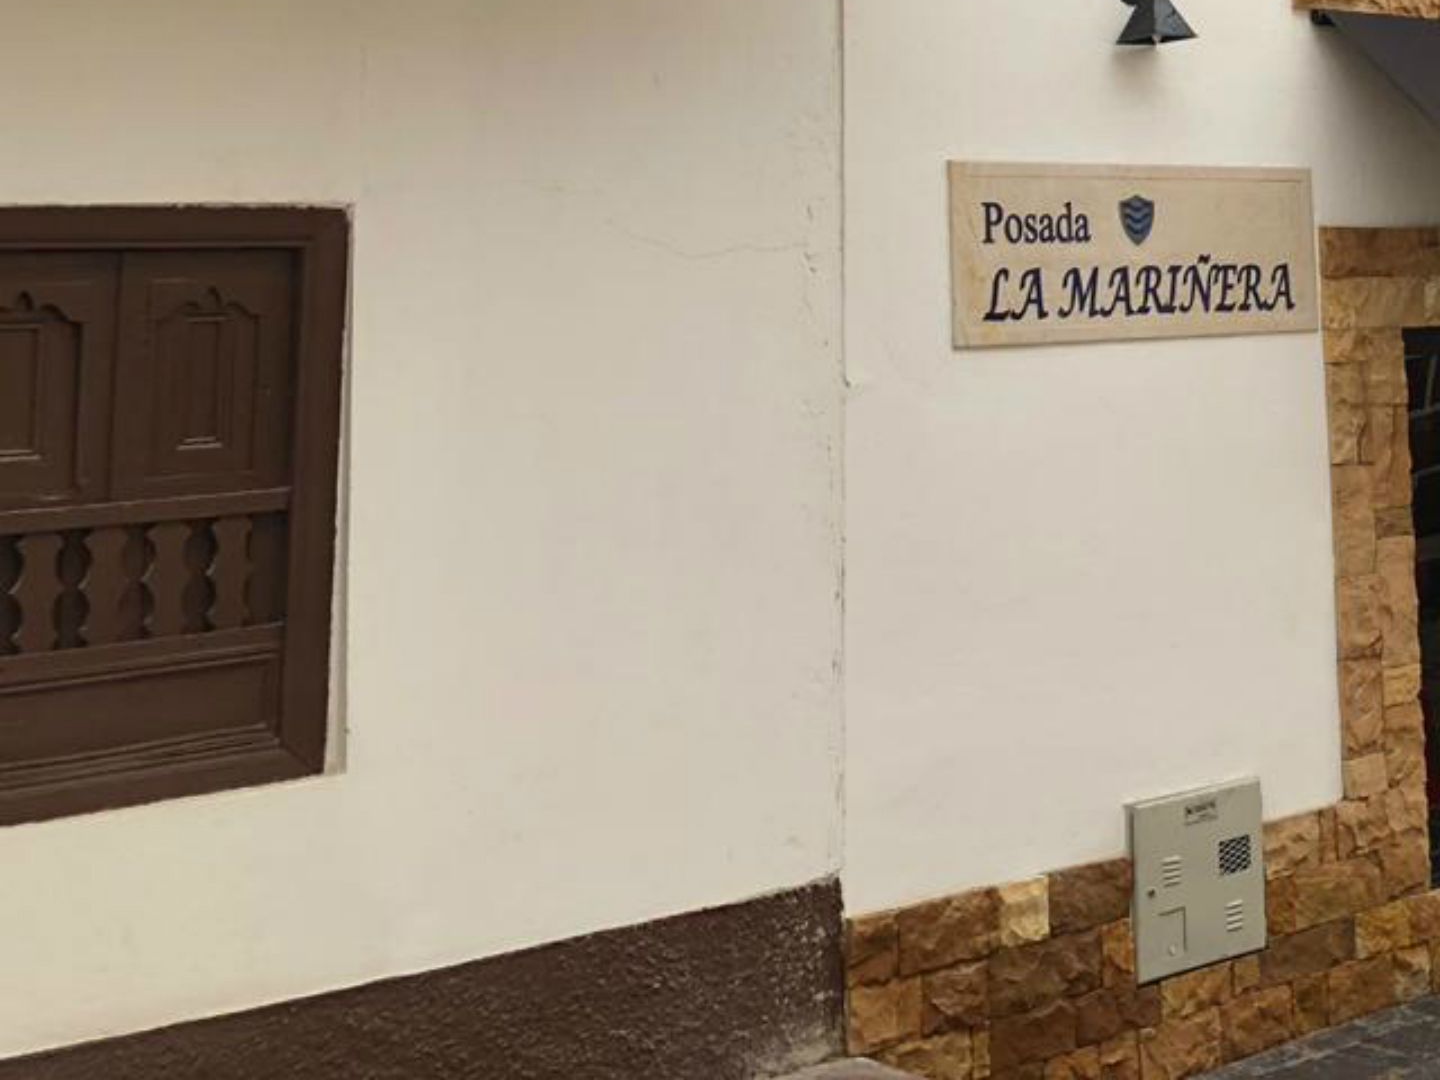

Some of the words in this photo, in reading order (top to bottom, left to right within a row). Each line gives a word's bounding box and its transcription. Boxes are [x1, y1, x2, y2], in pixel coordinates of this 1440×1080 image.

[981, 201, 1091, 244] Posada
[983, 267, 1048, 321] LA
[1057, 253, 1295, 318] MARIÑERA
